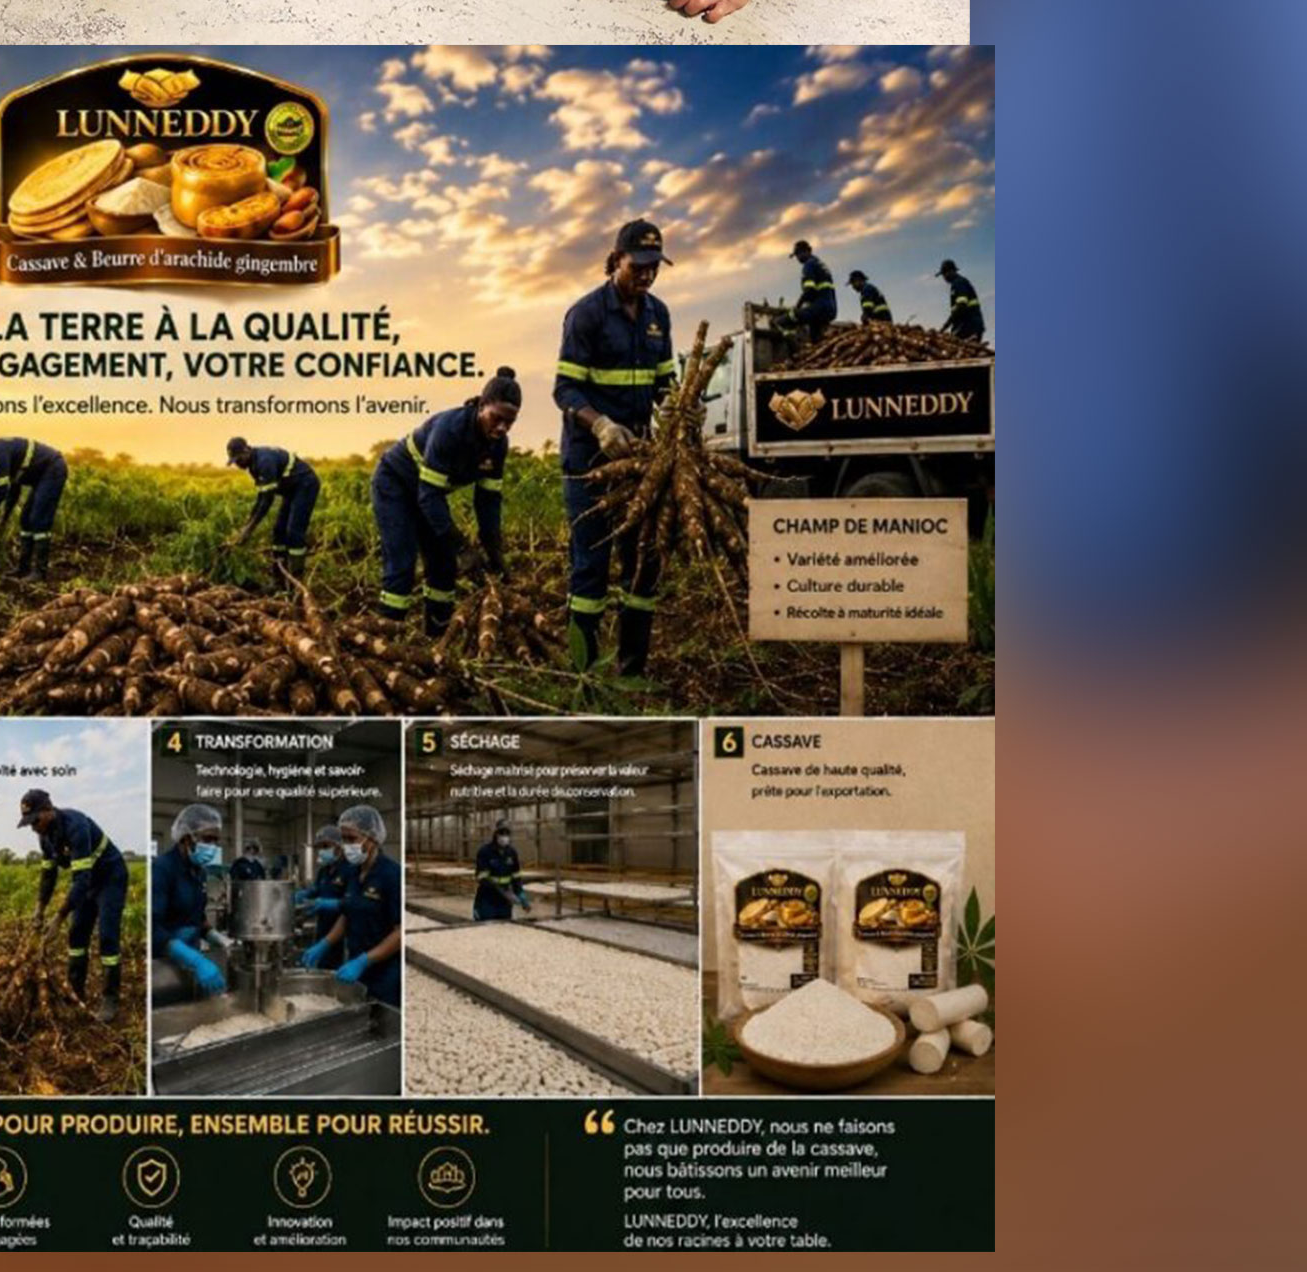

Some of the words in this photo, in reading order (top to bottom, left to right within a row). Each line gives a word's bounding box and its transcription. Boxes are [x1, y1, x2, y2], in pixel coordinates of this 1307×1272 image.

[56, 109, 259, 138] LUNNEDDY
[5, 253, 69, 272] Cassave
[73, 251, 87, 269] &
[92, 249, 146, 268] Beurre
[148, 247, 232, 268] d'arachide
[235, 253, 318, 275] gingembre
[39, 312, 144, 341] TERRE
[154, 304, 179, 341] À
[190, 312, 234, 341] LA
[244, 304, 400, 346] QUALITÉ,
[183, 351, 285, 378] VOTRE
[294, 351, 485, 378] CONFIANCE.
[33, 394, 153, 415] l'excellence.
[159, 394, 211, 415] Nous
[216, 394, 351, 415] transformons
[356, 395, 431, 416] l'avenir.
[831, 391, 973, 420] LUNNEDDY
[772, 517, 840, 535] CHAMP
[844, 517, 868, 535] DE
[872, 517, 949, 535] MANIOC
[786, 551, 841, 567] Variété
[844, 551, 920, 567] améliorée
[786, 577, 843, 593] Culture
[846, 578, 905, 593] durable
[786, 605, 836, 620] Récolte
[837, 606, 846, 619] à
[848, 606, 903, 619] maturité
[904, 606, 944, 620] idéale
[166, 732, 183, 753] 4
[195, 734, 334, 750] TRANSFORMATION
[421, 732, 437, 753] 5
[450, 731, 520, 750] SÉCHAGE
[721, 732, 738, 753] 6
[751, 733, 821, 749] CASSAVE
[19, 766, 47, 777] avec
[51, 764, 77, 777] soin
[195, 763, 266, 780] Technologie,
[313, 764, 326, 777] et
[450, 763, 494, 780] Séchage
[535, 766, 559, 780] pour
[607, 764, 618, 777] la
[751, 763, 802, 777] Cassave
[804, 763, 821, 777] de
[823, 763, 858, 777] haute
[860, 763, 906, 779] qualité,
[195, 784, 223, 798] faire
[223, 787, 251, 800] pour
[252, 787, 274, 798] une
[275, 784, 316, 800] qualité
[494, 785, 506, 798] et
[507, 785, 518, 798] la
[518, 784, 550, 798] durée
[551, 784, 565, 798] de
[785, 787, 813, 799] pour
[61, 1114, 184, 1138] PRODUIRE,
[191, 1114, 309, 1135] ENSEMBLE
[317, 1114, 382, 1135] POUR
[389, 1109, 490, 1135] RÉUSSIR.
[623, 1118, 665, 1135] Chez
[670, 1117, 765, 1137] LUNNEDDY,
[770, 1121, 809, 1135] nous
[813, 1121, 834, 1135] ne
[838, 1117, 896, 1134] faisons
[623, 1142, 654, 1159] pas
[657, 1142, 689, 1159] que
[692, 1139, 762, 1159] produire
[765, 1139, 787, 1157] de
[791, 1139, 806, 1156] la
[810, 1143, 879, 1157] cassave,
[624, 1165, 664, 1178] nous
[747, 1165, 768, 1178] un
[771, 1161, 820, 1178] avenir
[824, 1161, 888, 1178] meilleur
[623, 1186, 662, 1203] pour
[666, 1184, 706, 1200] tous.
[0, 1214, 51, 1229] formées
[128, 1214, 174, 1229] Qualité
[267, 1215, 334, 1229] Innovation
[387, 1215, 431, 1230] Impact
[433, 1214, 472, 1231] positif
[474, 1215, 505, 1229] dans
[624, 1213, 710, 1230] LUNNEDDY,
[714, 1213, 799, 1229] l'excellence
[111, 1234, 125, 1246] et
[128, 1232, 191, 1248] traçabilité
[253, 1234, 267, 1246] et
[269, 1232, 347, 1246] amélioration
[387, 1235, 411, 1246] nos
[623, 1232, 644, 1248] de
[646, 1236, 674, 1248] nos
[678, 1233, 731, 1248] racines
[735, 1233, 744, 1248] à
[747, 1234, 786, 1248] votre
[790, 1232, 831, 1248] table.
